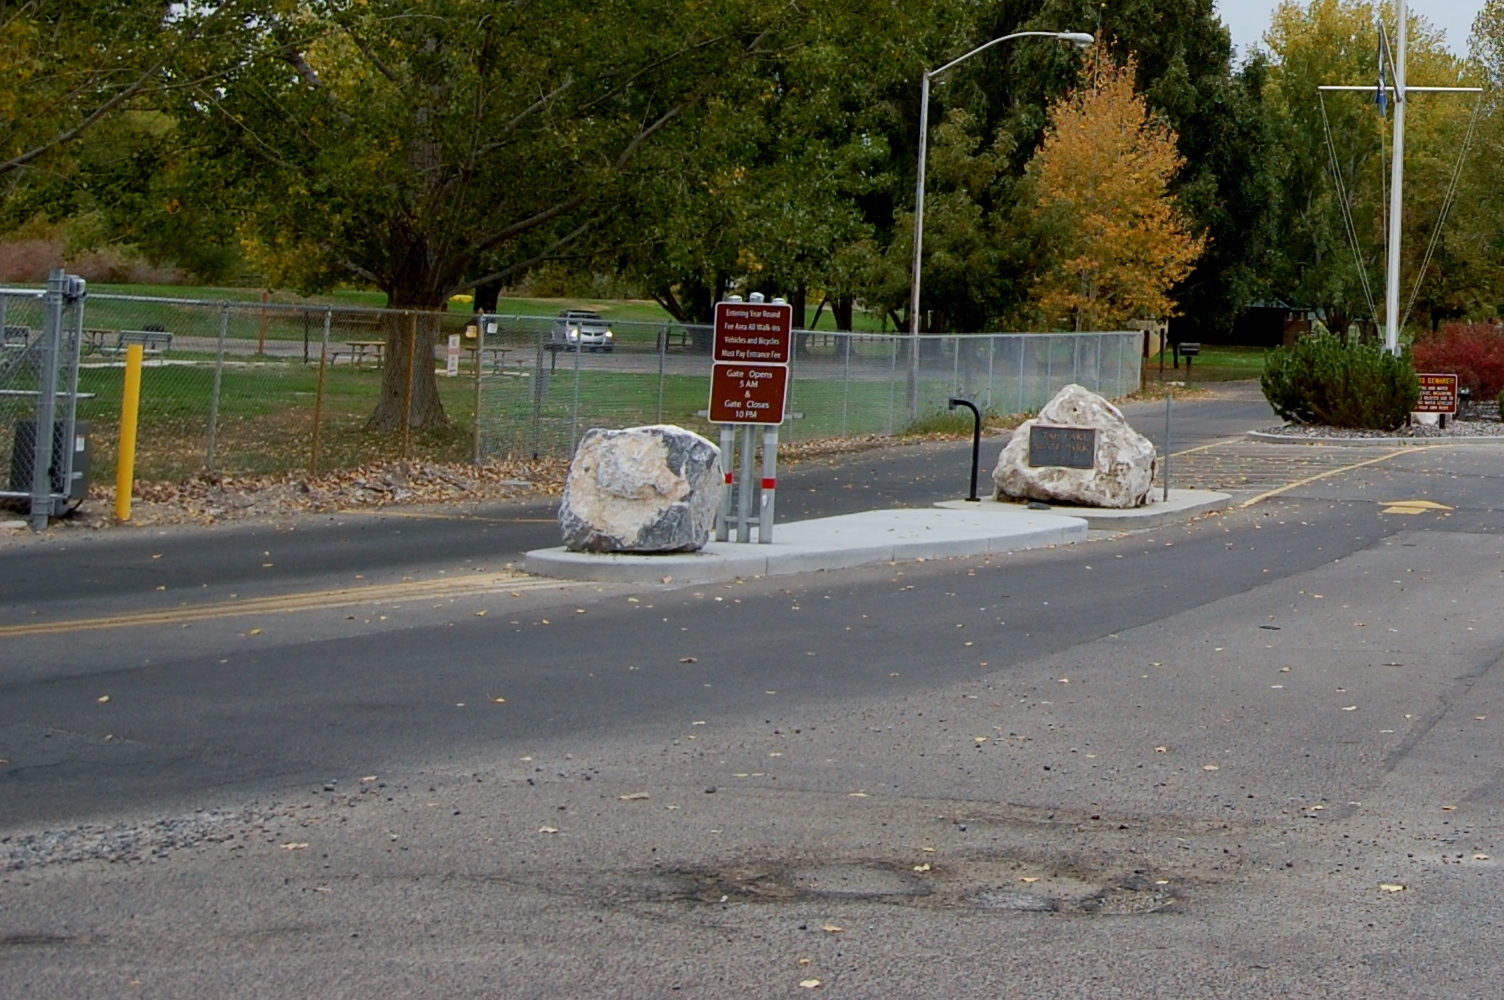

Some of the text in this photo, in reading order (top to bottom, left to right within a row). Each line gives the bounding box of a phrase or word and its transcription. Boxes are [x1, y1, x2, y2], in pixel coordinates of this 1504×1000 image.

[724, 336, 746, 344] Vehicles
[736, 350, 746, 359] Pay
[726, 369, 773, 379] Gate Opens
[745, 380, 758, 388] AM
[744, 390, 750, 398] &
[724, 399, 769, 408] Gate Closes
